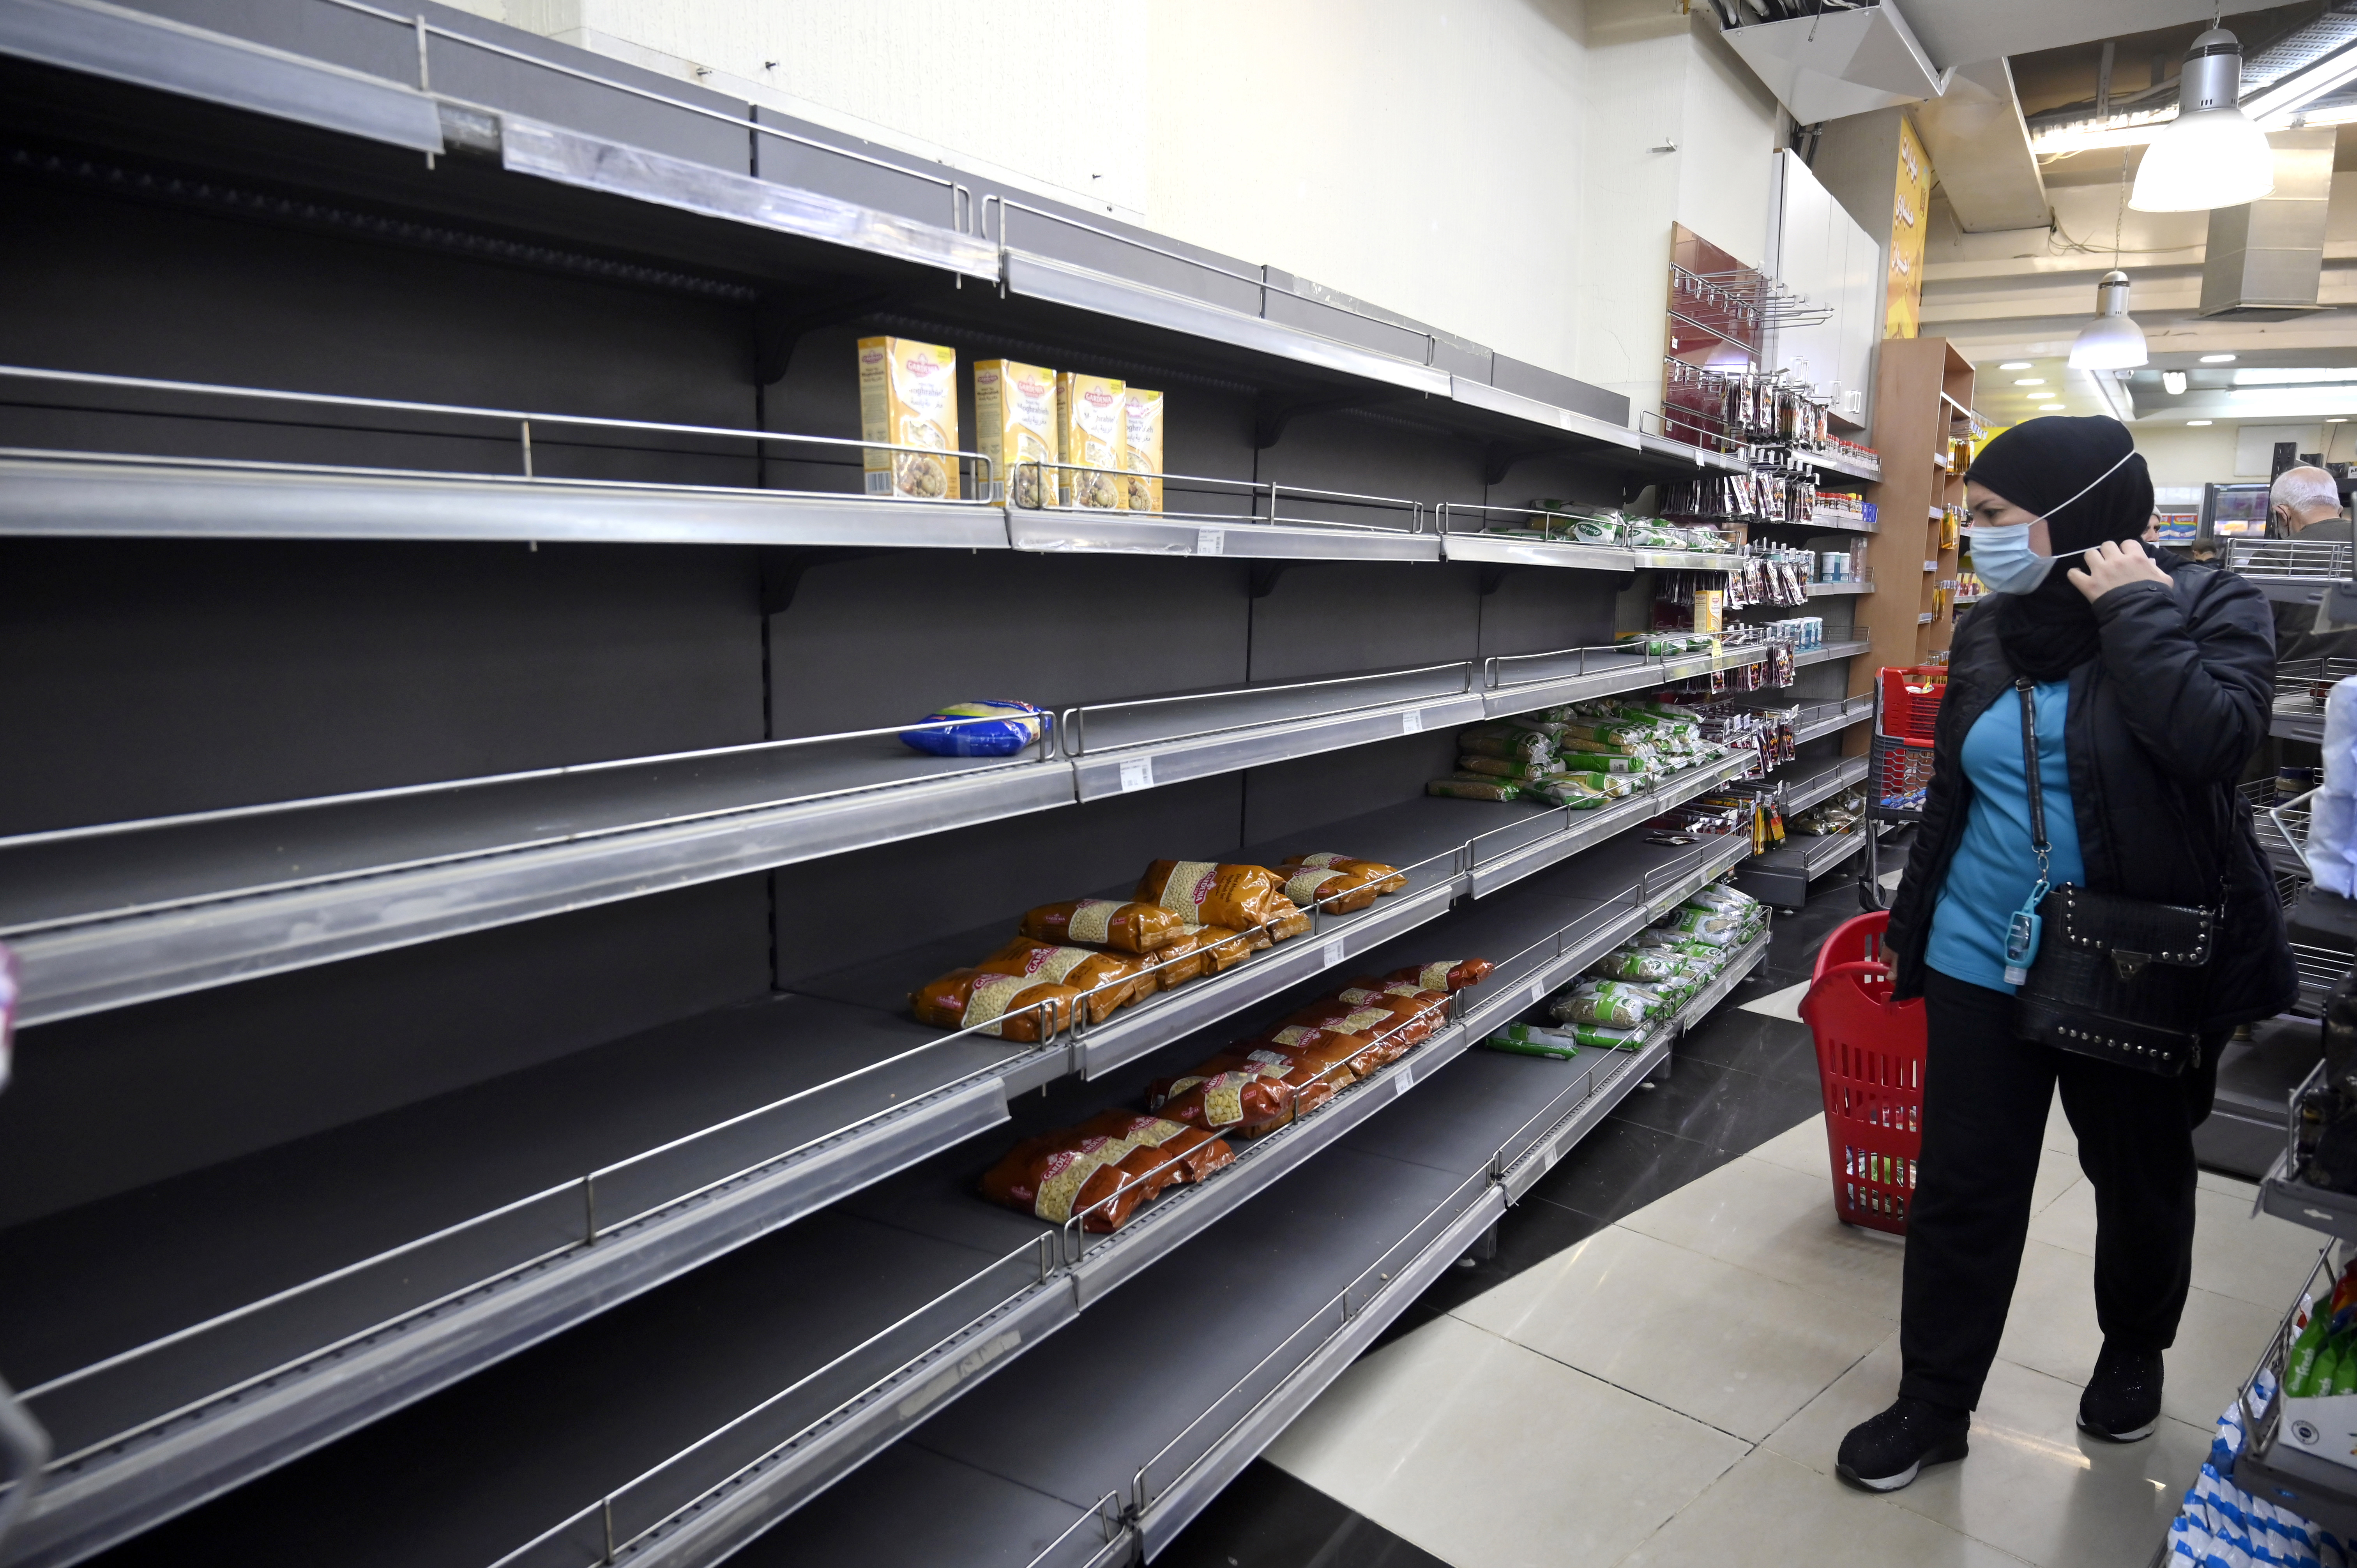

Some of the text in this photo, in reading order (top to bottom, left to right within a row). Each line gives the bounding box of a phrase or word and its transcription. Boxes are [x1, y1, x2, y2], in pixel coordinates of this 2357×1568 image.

[1901, 136, 1918, 189] بهارات
[1895, 192, 1914, 231] حلباوي
[1127, 424, 1153, 433] oghraieh
[1682, 913, 1694, 926] Pulses
[1029, 948, 1051, 971] GARDE
[1300, 1029, 1317, 1046] RDENIA
[1204, 1075, 1219, 1091] GARDE
[1082, 1136, 1106, 1153] ARDEN
[1043, 1151, 1069, 1179] GARDEN
